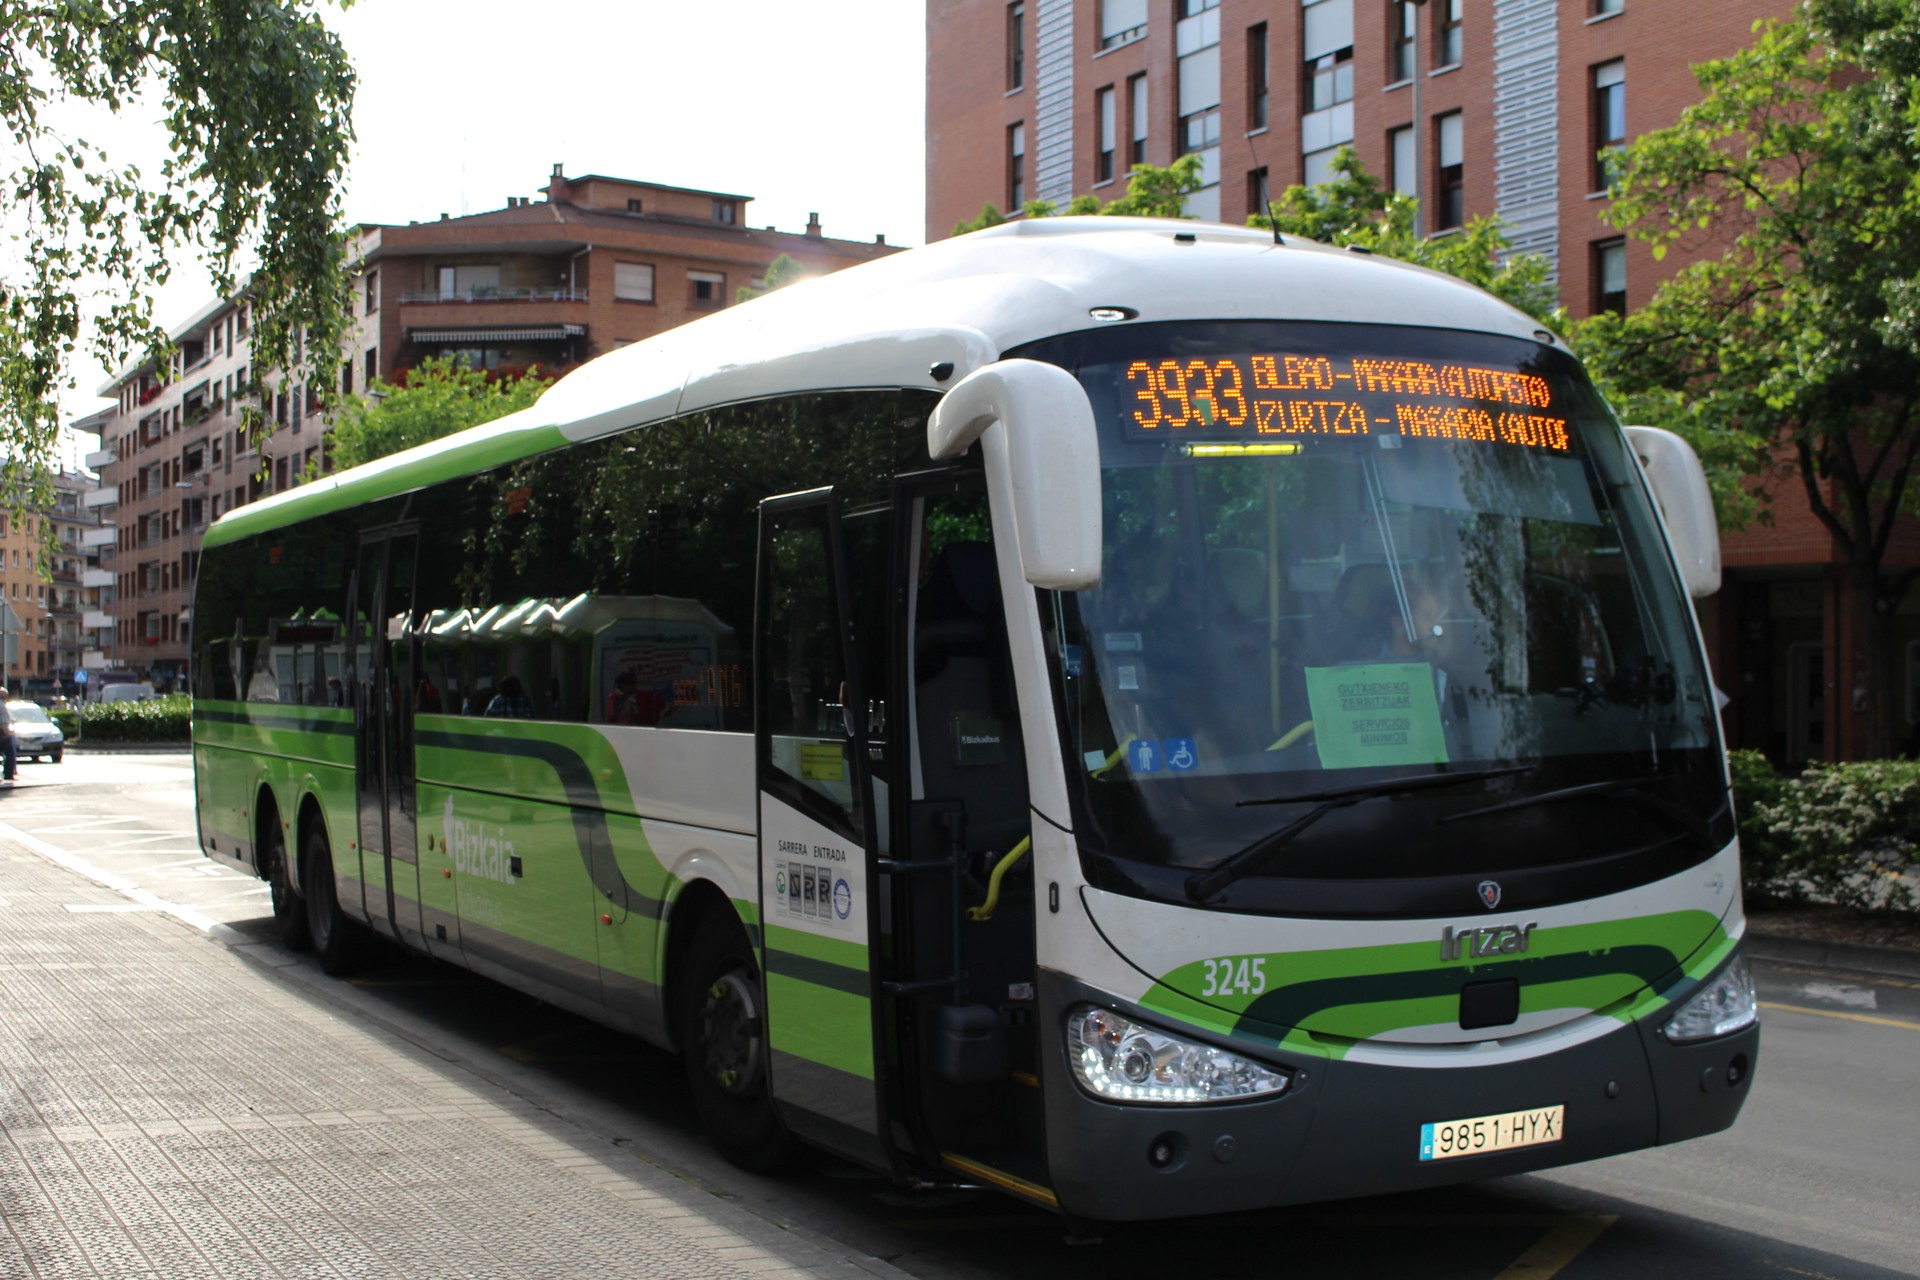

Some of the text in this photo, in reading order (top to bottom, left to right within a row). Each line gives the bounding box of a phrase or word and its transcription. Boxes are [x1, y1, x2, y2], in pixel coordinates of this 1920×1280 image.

[1127, 360, 1248, 428] 3933
[1253, 399, 1369, 435] IZURTZA
[1352, 717, 1411, 732] SERVICIOS
[778, 839, 847, 863] SARRERA ENTRADA
[1441, 920, 1538, 961] Irizar
[1202, 957, 1266, 997] 3245
[1440, 1110, 1557, 1153] 9851 HYX
